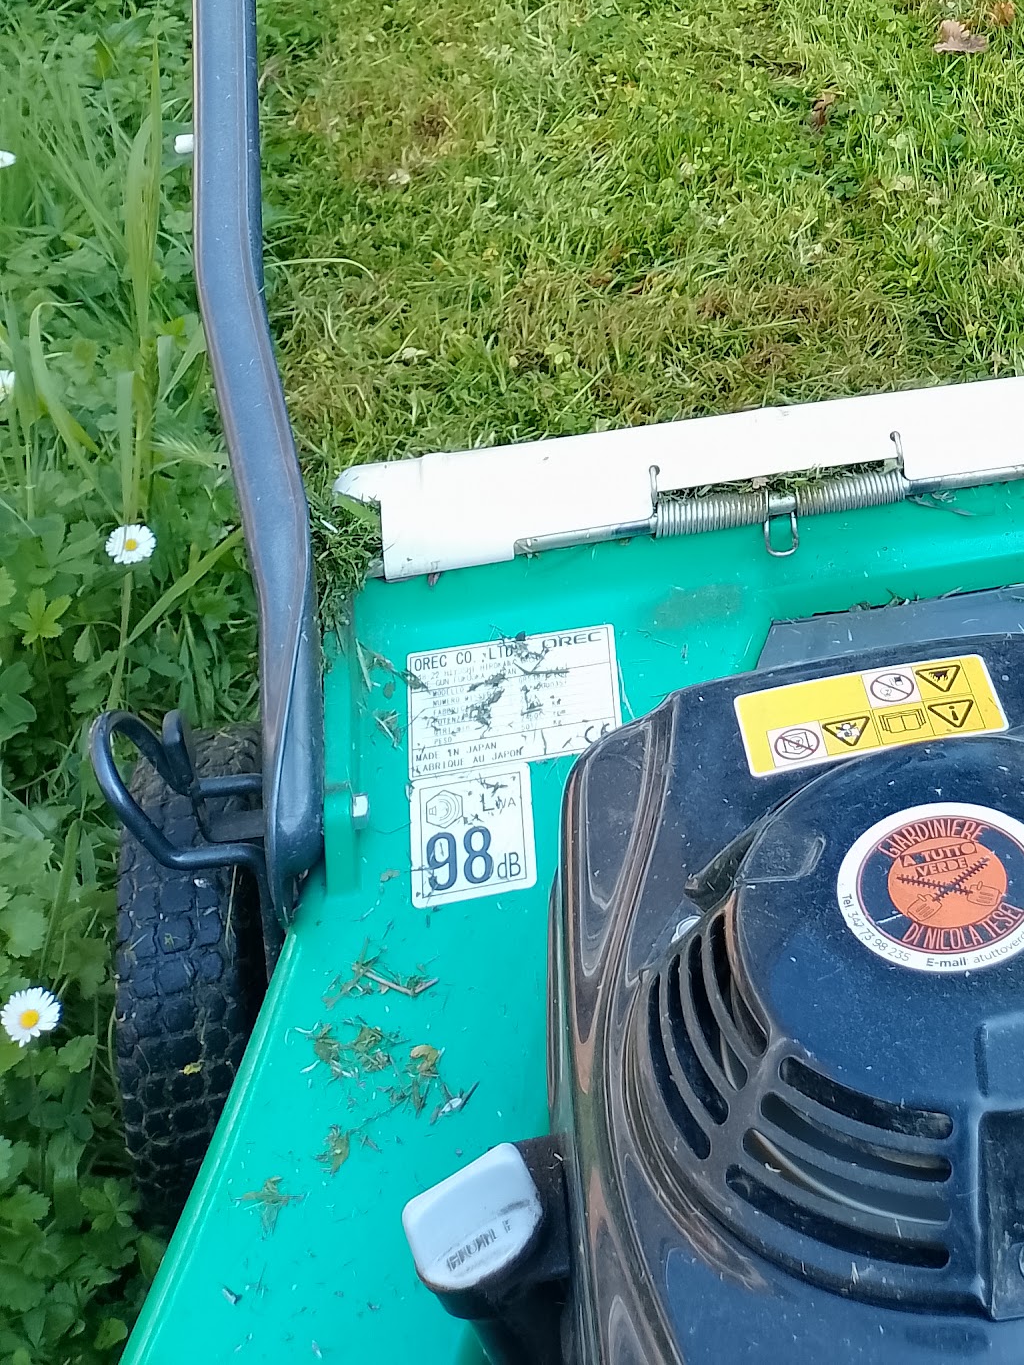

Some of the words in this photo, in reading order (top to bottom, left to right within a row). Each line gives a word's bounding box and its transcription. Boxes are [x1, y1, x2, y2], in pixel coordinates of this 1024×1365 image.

[542, 631, 602, 649] OREC
[414, 655, 447, 671] OREC
[415, 751, 438, 762] MADE
[467, 742, 497, 754] JAPAN
[473, 754, 485, 764] AU
[492, 748, 522, 761] JAPON
[877, 818, 989, 858] GIARDINIERE
[426, 825, 494, 891] 98
[497, 851, 521, 880] dB
[903, 853, 917, 867] A
[920, 841, 977, 863] TUTTO
[916, 856, 967, 878] VERDE
[923, 924, 984, 950] NICOLA
